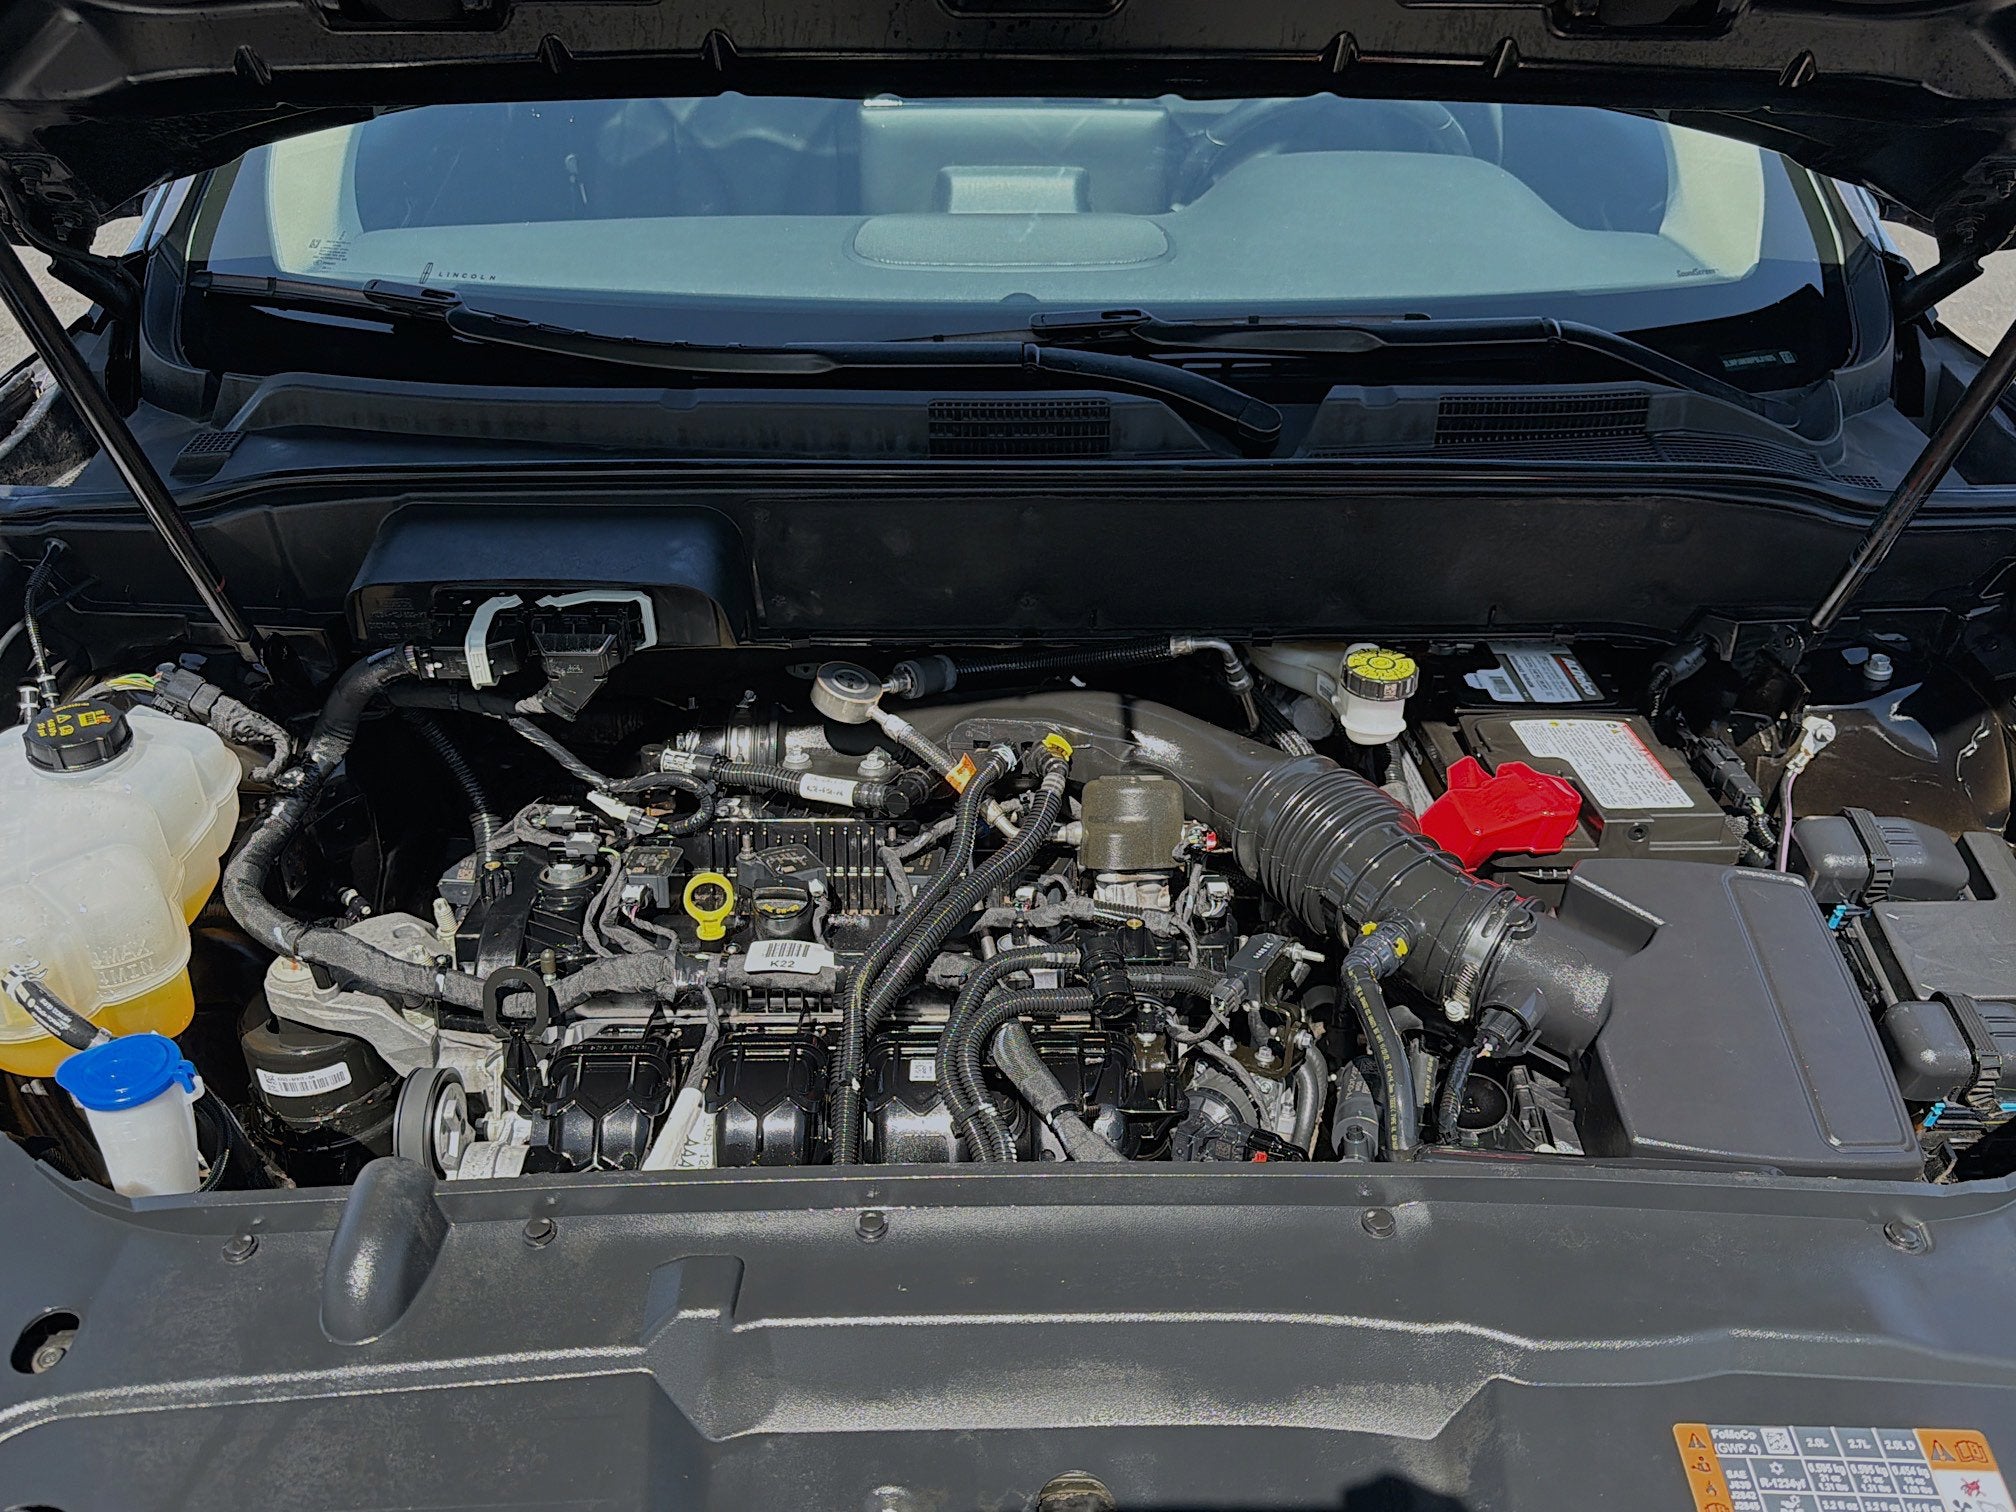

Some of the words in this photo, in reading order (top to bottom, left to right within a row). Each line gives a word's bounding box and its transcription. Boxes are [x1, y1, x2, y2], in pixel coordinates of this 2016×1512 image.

[438, 271, 496, 281] LINCOLN
[769, 960, 795, 969] K22
[1711, 1429, 1757, 1440] FoMoCo
[1714, 1443, 1747, 1454] (GWP
[1748, 1443, 1761, 1455] 4)
